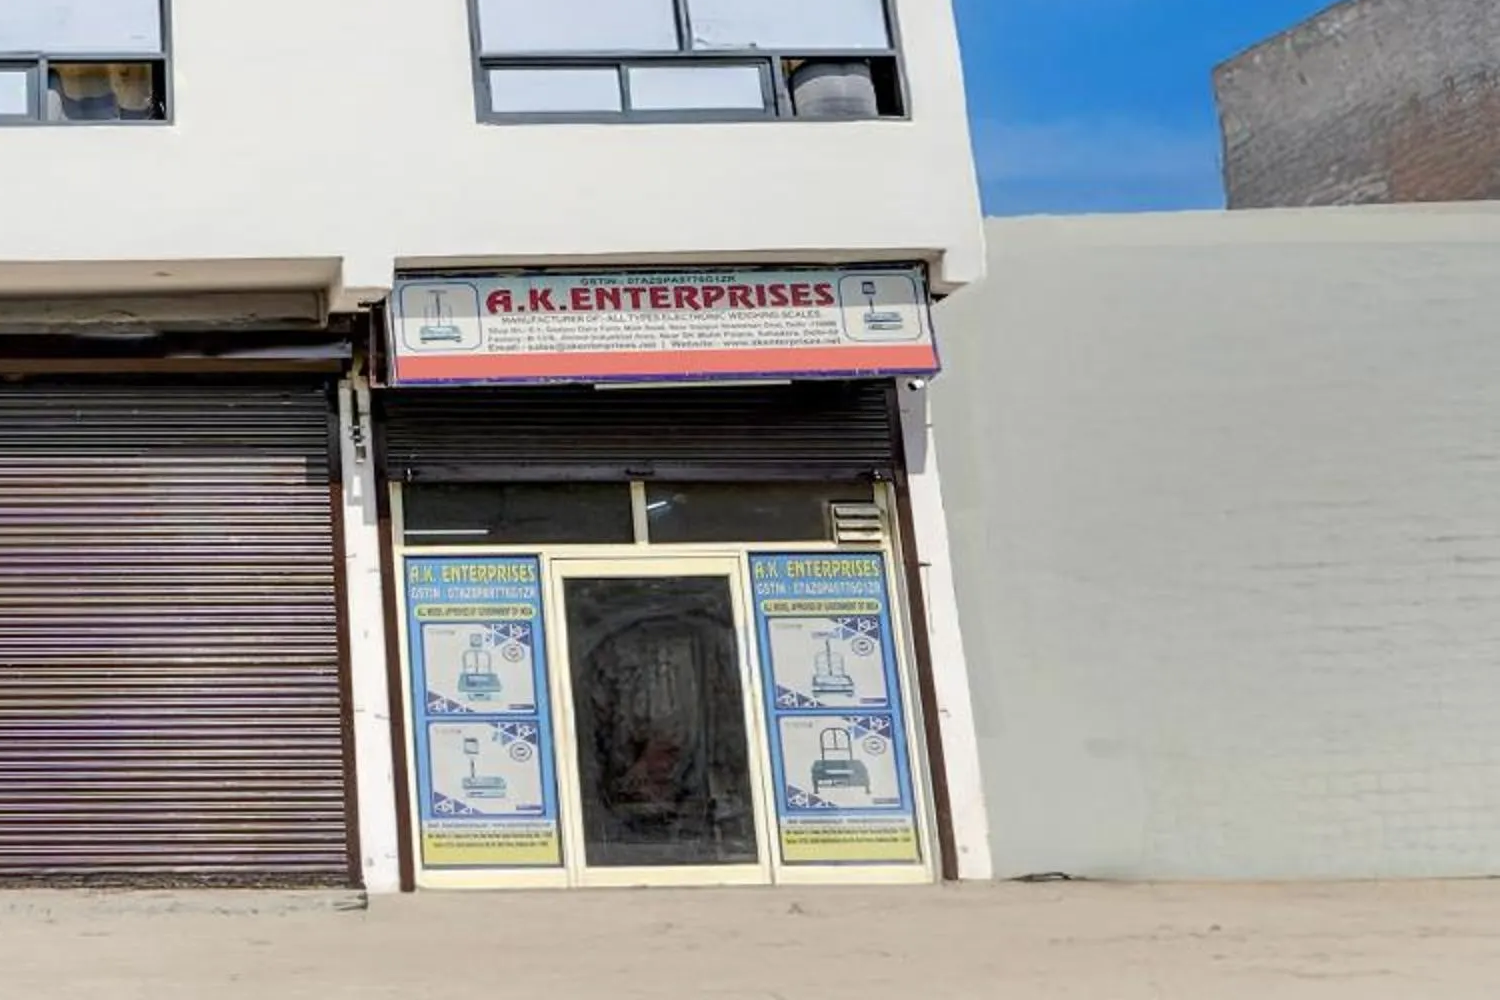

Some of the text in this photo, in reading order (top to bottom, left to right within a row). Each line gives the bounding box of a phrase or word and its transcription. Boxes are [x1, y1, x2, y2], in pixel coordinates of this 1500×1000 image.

[781, 310, 820, 319] SCALES
[441, 564, 534, 583] ENTERPRISES
[786, 559, 880, 579] ENTERPRISES
